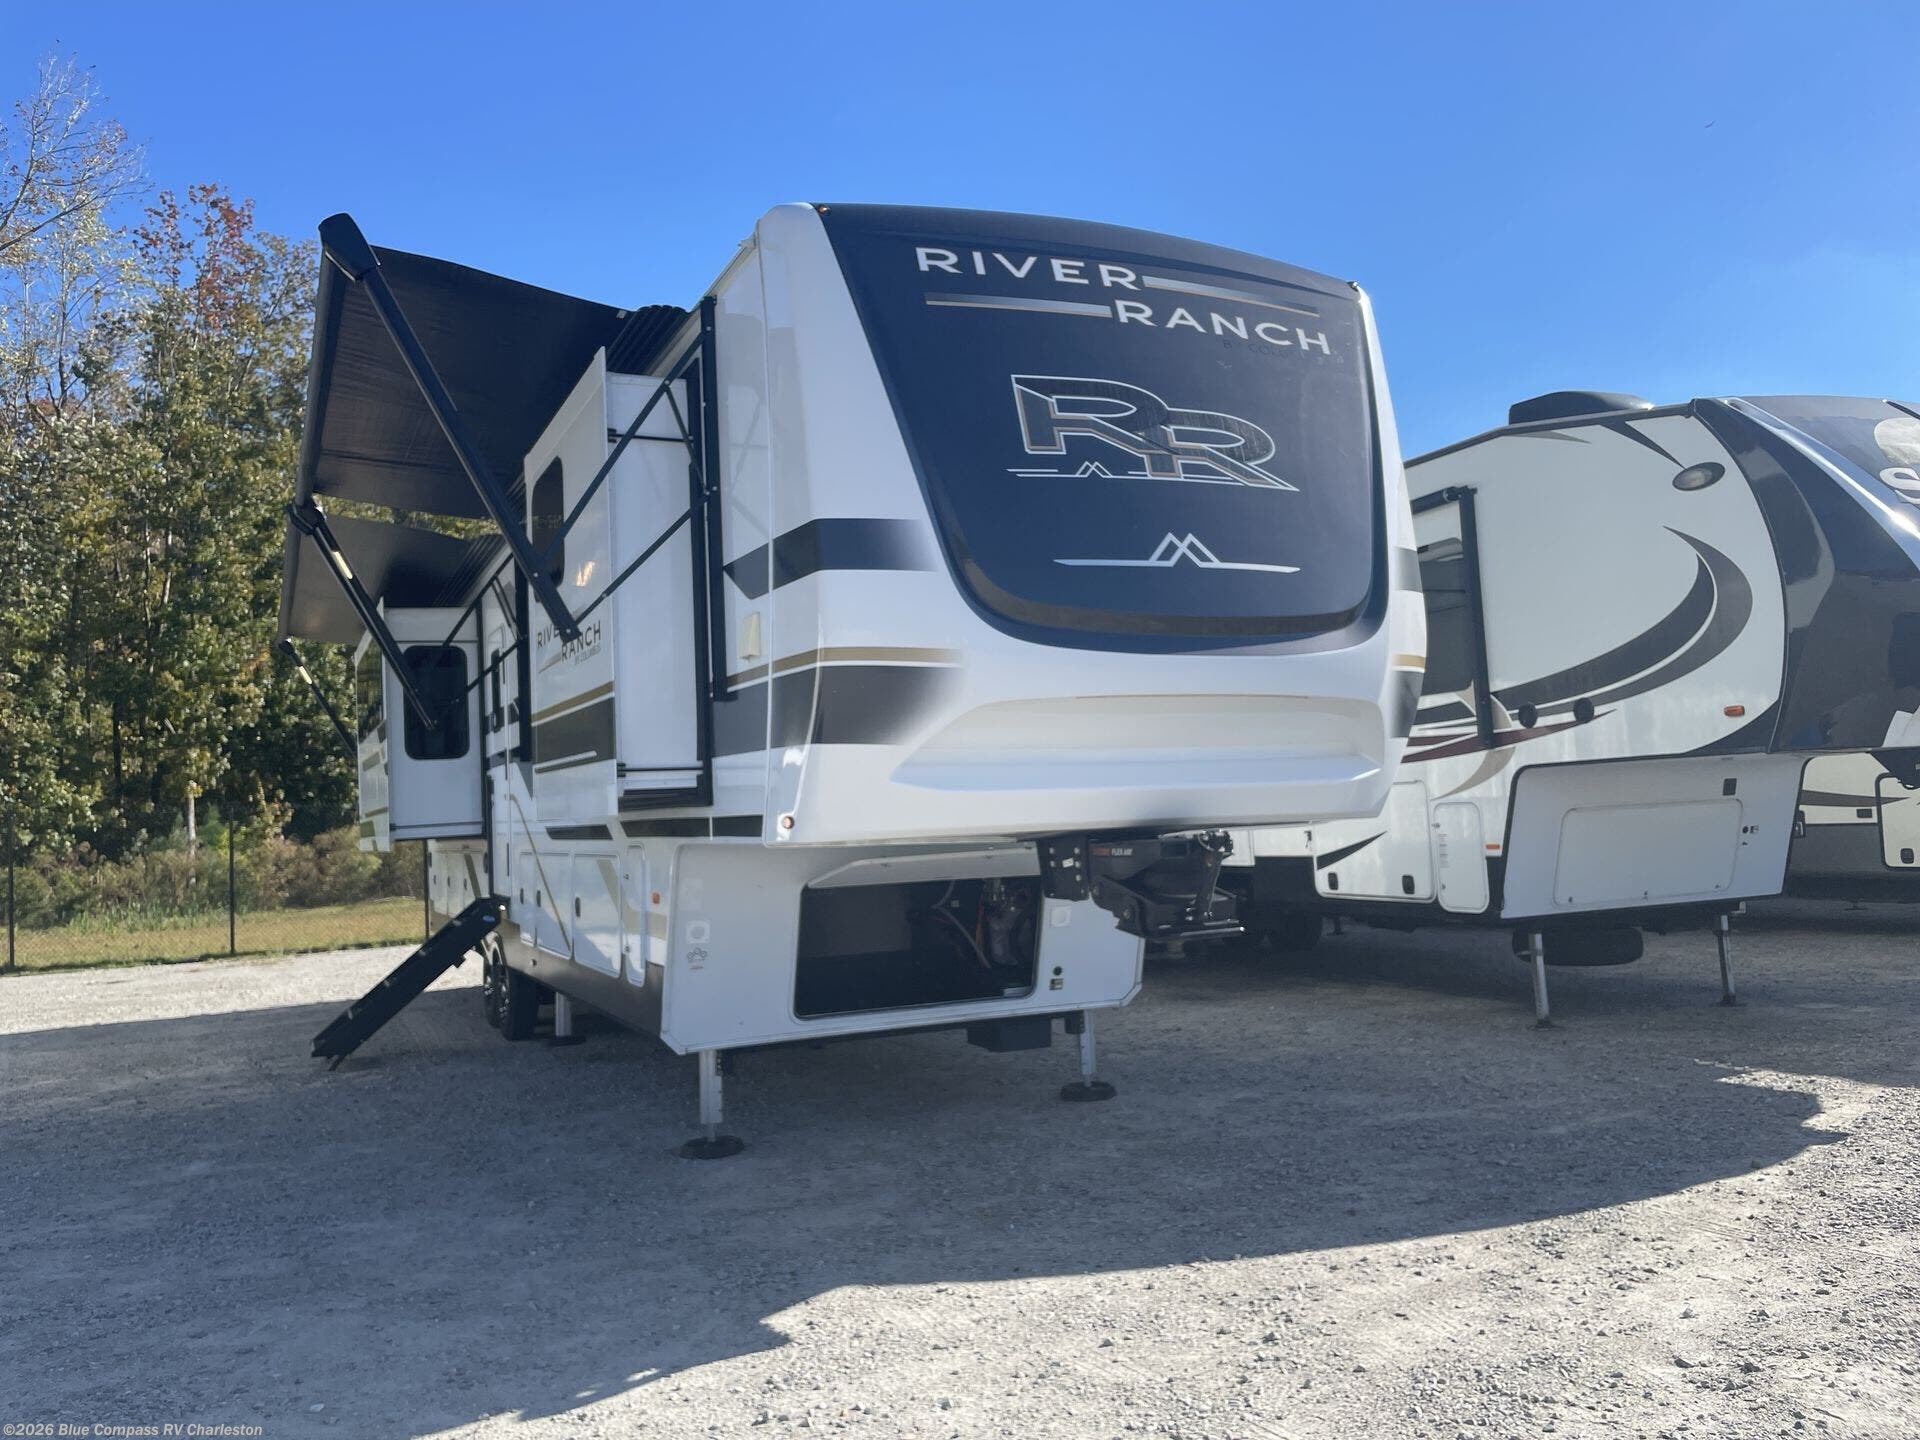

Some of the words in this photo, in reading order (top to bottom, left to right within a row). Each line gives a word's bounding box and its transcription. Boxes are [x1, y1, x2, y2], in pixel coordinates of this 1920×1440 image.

[915, 246, 1141, 291] RIVER
[1114, 299, 1332, 355] RANCH
[537, 621, 561, 650] RIVE
[561, 619, 601, 662] RANCH
